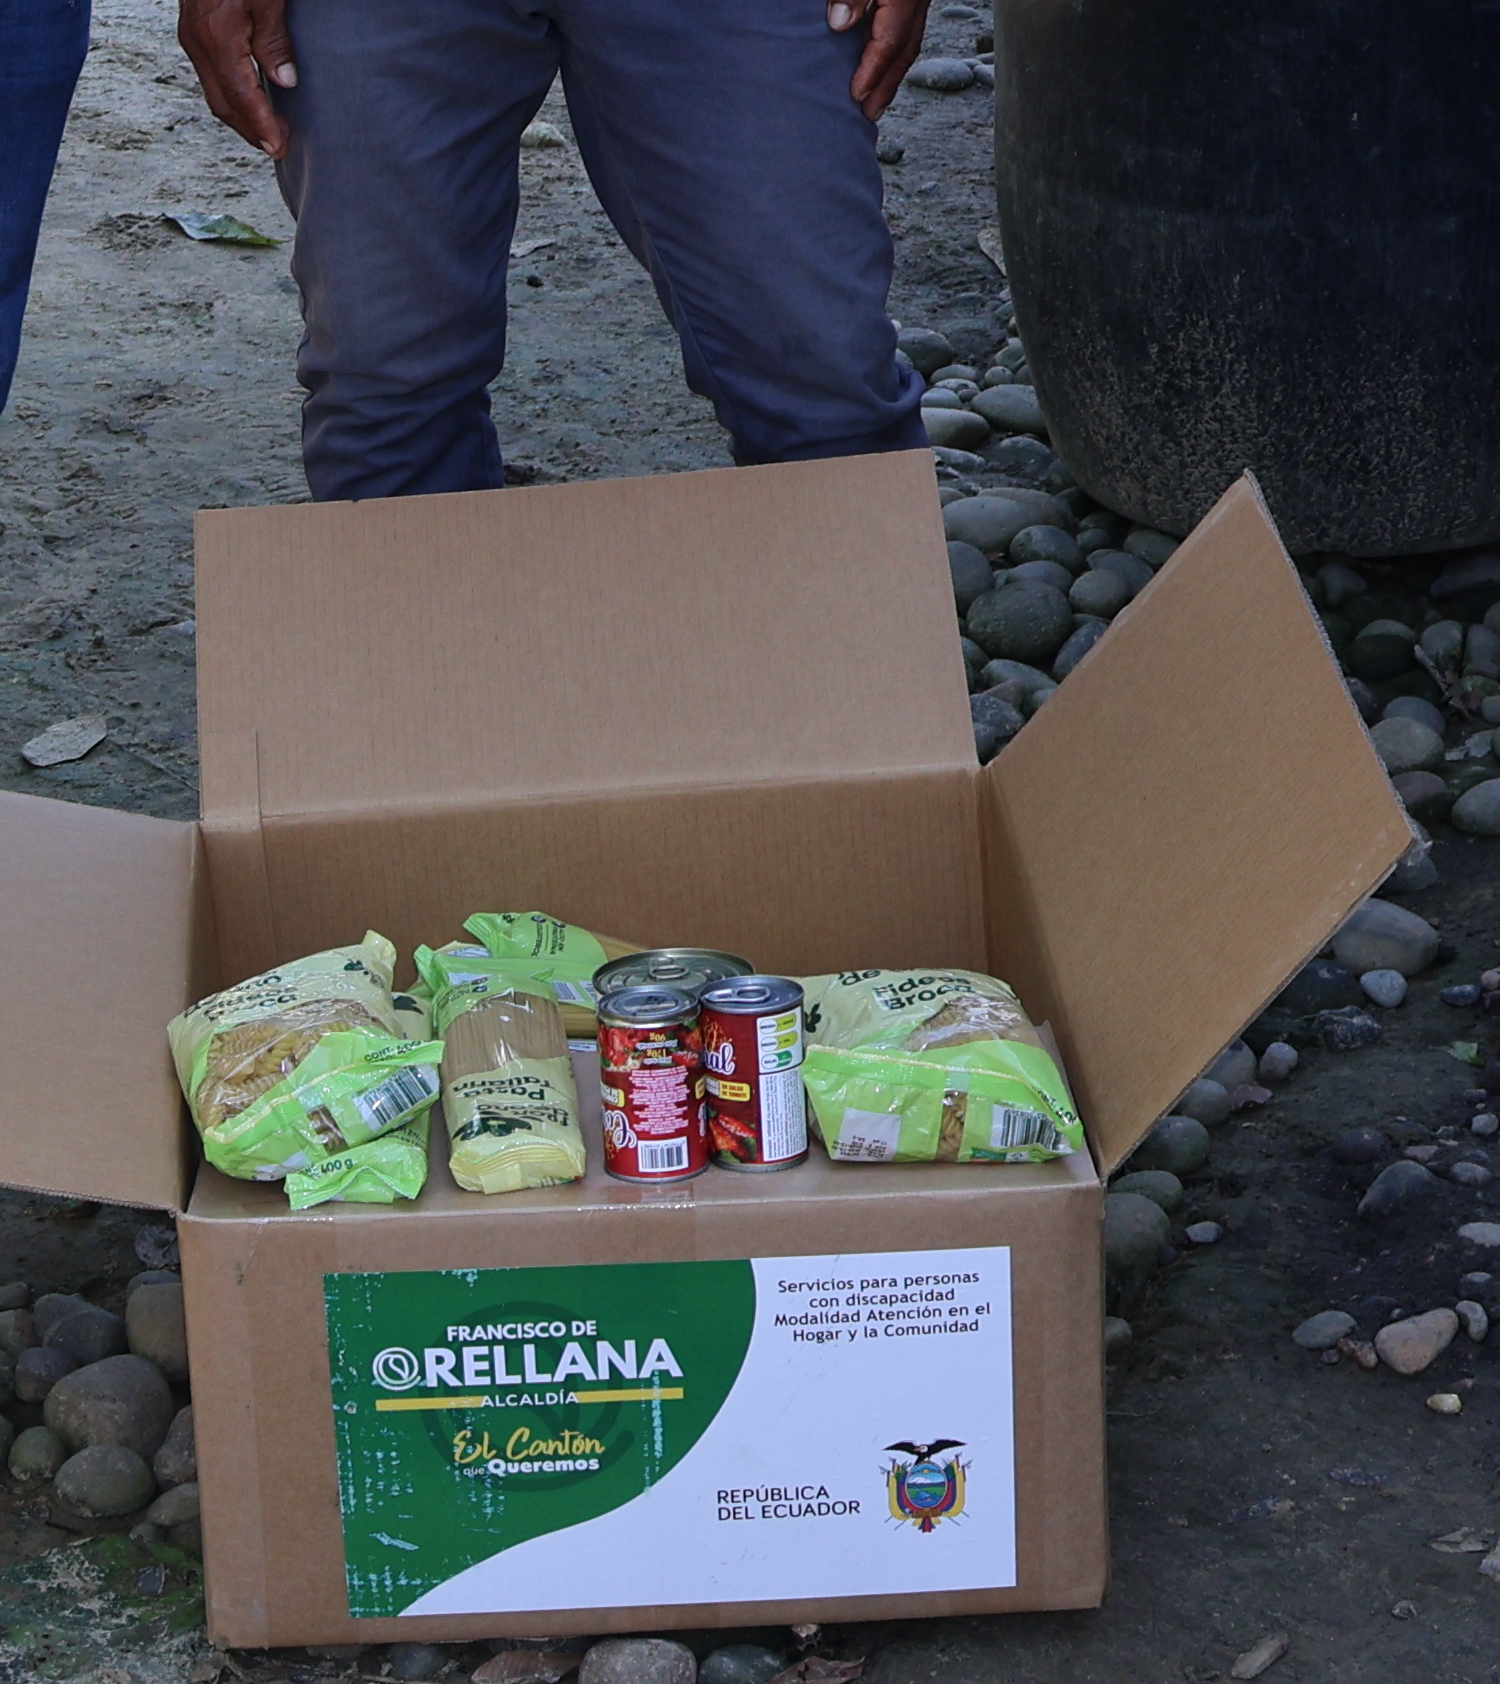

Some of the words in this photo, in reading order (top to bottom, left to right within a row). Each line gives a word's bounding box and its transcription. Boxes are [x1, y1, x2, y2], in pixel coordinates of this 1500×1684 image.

[778, 1279, 854, 1293] Servicios
[860, 1276, 898, 1292] para
[904, 1271, 980, 1289] personas
[809, 1295, 840, 1309] con
[846, 1288, 955, 1307] discapacidad
[774, 1309, 861, 1327] Modalidad
[866, 1306, 942, 1323] Atención
[948, 1306, 969, 1317] en
[975, 1302, 991, 1315] el
[447, 1320, 567, 1341] FRANCISCO
[571, 1320, 597, 1336] DE
[792, 1328, 842, 1344] Hogar
[848, 1328, 858, 1343] y
[864, 1325, 878, 1339] la
[884, 1319, 979, 1338] Comunidad
[372, 1338, 684, 1391] ORELLANA
[480, 1389, 579, 1408] ALCALDÍA
[453, 1429, 497, 1464] El
[506, 1426, 606, 1461] Cantón
[463, 1466, 485, 1476] que
[487, 1458, 600, 1478] Queremos
[717, 1484, 830, 1504] REPÚBLICA
[718, 1505, 755, 1521] DEL
[761, 1500, 861, 1519] ECUADOR
